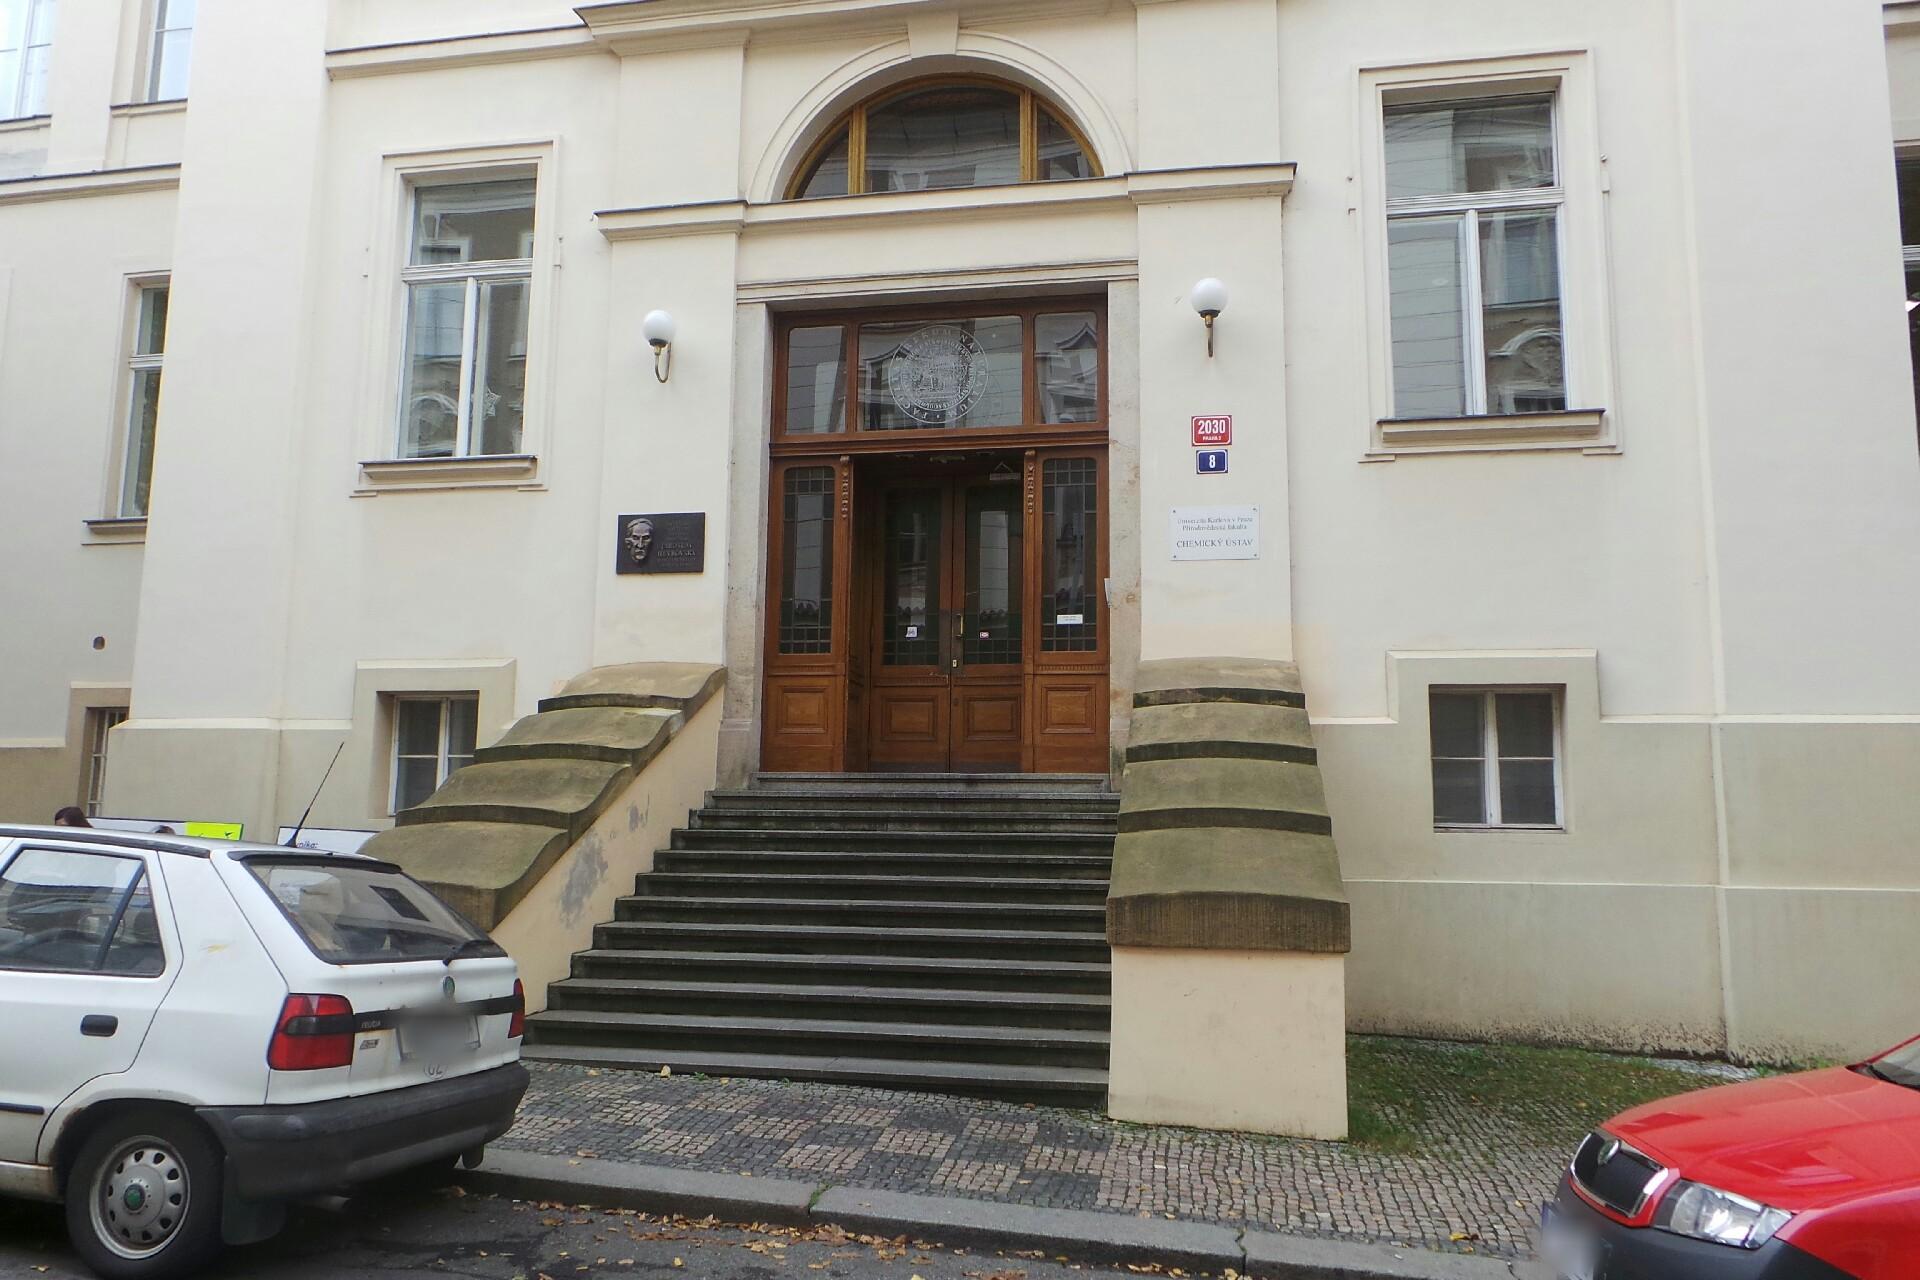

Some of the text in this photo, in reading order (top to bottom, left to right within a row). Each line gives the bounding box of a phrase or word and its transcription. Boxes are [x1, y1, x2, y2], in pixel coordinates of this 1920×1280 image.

[1198, 419, 1226, 434] 2030
[1209, 454, 1216, 469] 8
[1176, 537, 1254, 548] CHEMICKÝ ÚSTAV
